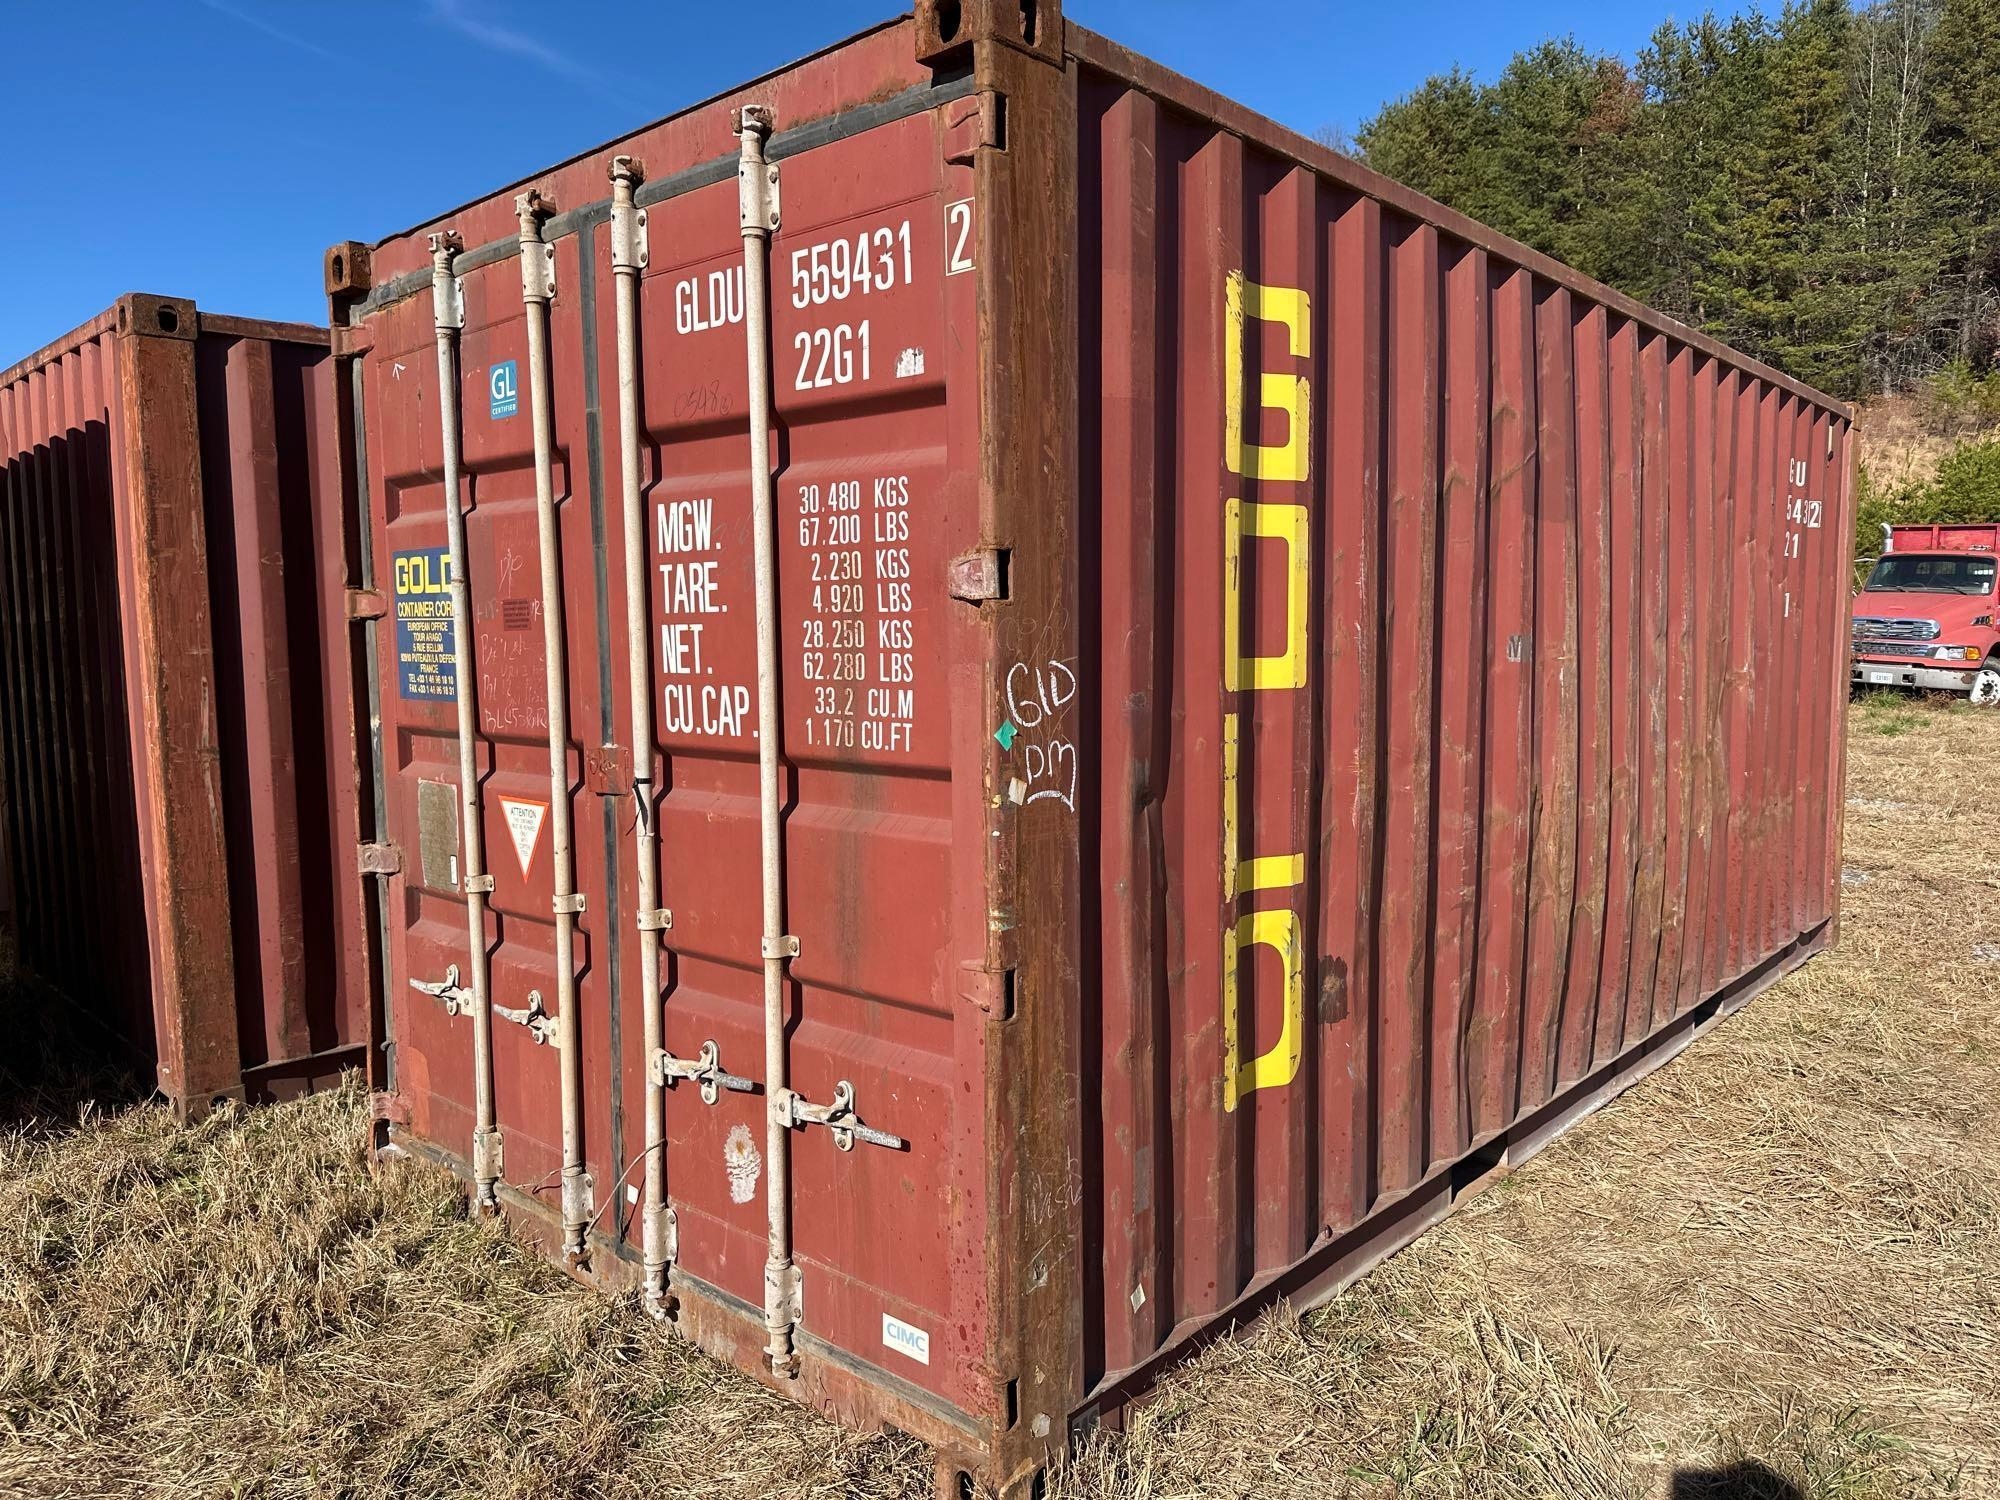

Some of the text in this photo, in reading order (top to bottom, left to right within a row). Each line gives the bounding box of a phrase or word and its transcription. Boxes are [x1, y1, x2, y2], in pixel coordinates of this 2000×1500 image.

[675, 202, 974, 334] GLDU 559431 2
[794, 319, 870, 391] 22G1
[491, 366, 516, 400] GL
[492, 403, 516, 416] CERTIFIED
[657, 498, 722, 554] MGW.
[874, 475, 909, 509] KGS
[874, 510, 909, 543] LBS
[395, 553, 452, 595] GOLD
[659, 561, 728, 614] TARE.
[875, 548, 911, 580] KGS
[397, 602, 434, 617] CONTAINER
[877, 582, 912, 613] LBS
[407, 622, 448, 631] EUROPEAN OFFICE
[413, 633, 425, 641] TOUR
[661, 623, 713, 675] NET.
[878, 619, 913, 650] KGS
[420, 664, 439, 673] FRANCE
[879, 652, 914, 683] LBS
[814, 686, 854, 716] 33.2
[867, 688, 914, 719] CU.M
[861, 720, 914, 752] CU.FT
[510, 807, 537, 819] ATTENTION
[886, 1322, 926, 1353] CIMC
